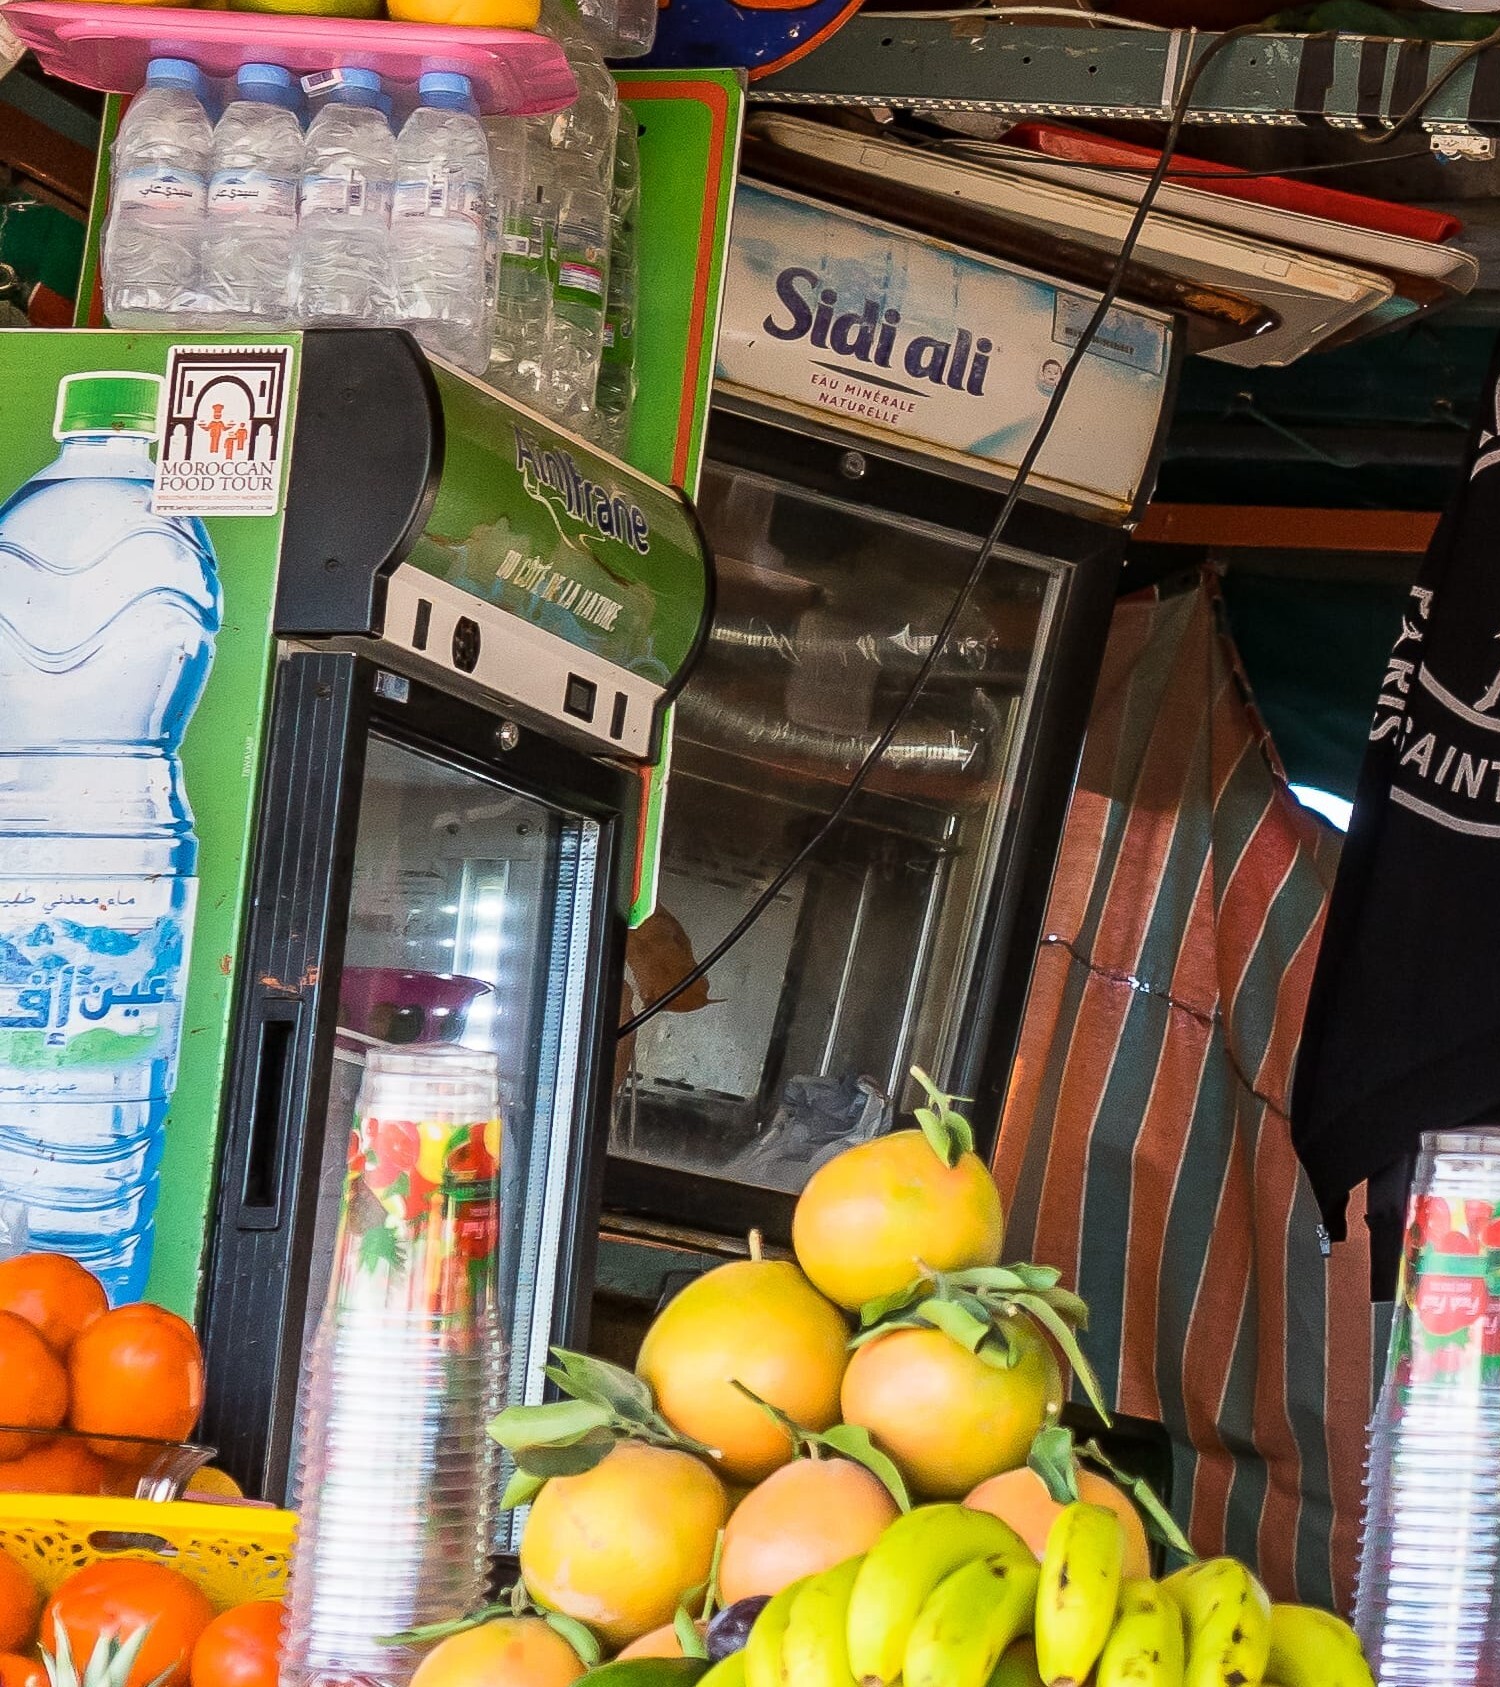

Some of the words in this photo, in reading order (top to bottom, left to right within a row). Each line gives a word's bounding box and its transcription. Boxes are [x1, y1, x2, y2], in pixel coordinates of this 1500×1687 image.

[763, 267, 900, 368] Sidi
[904, 328, 993, 397] ali
[811, 374, 839, 390] EAU
[844, 382, 916, 413] MINÉRALE
[819, 392, 899, 425] NATURELLE
[160, 477, 214, 491] FOOD
[220, 477, 273, 491] TOUR
[161, 461, 275, 476] MOROCCAN
[79, 975, 167, 1021] عين
